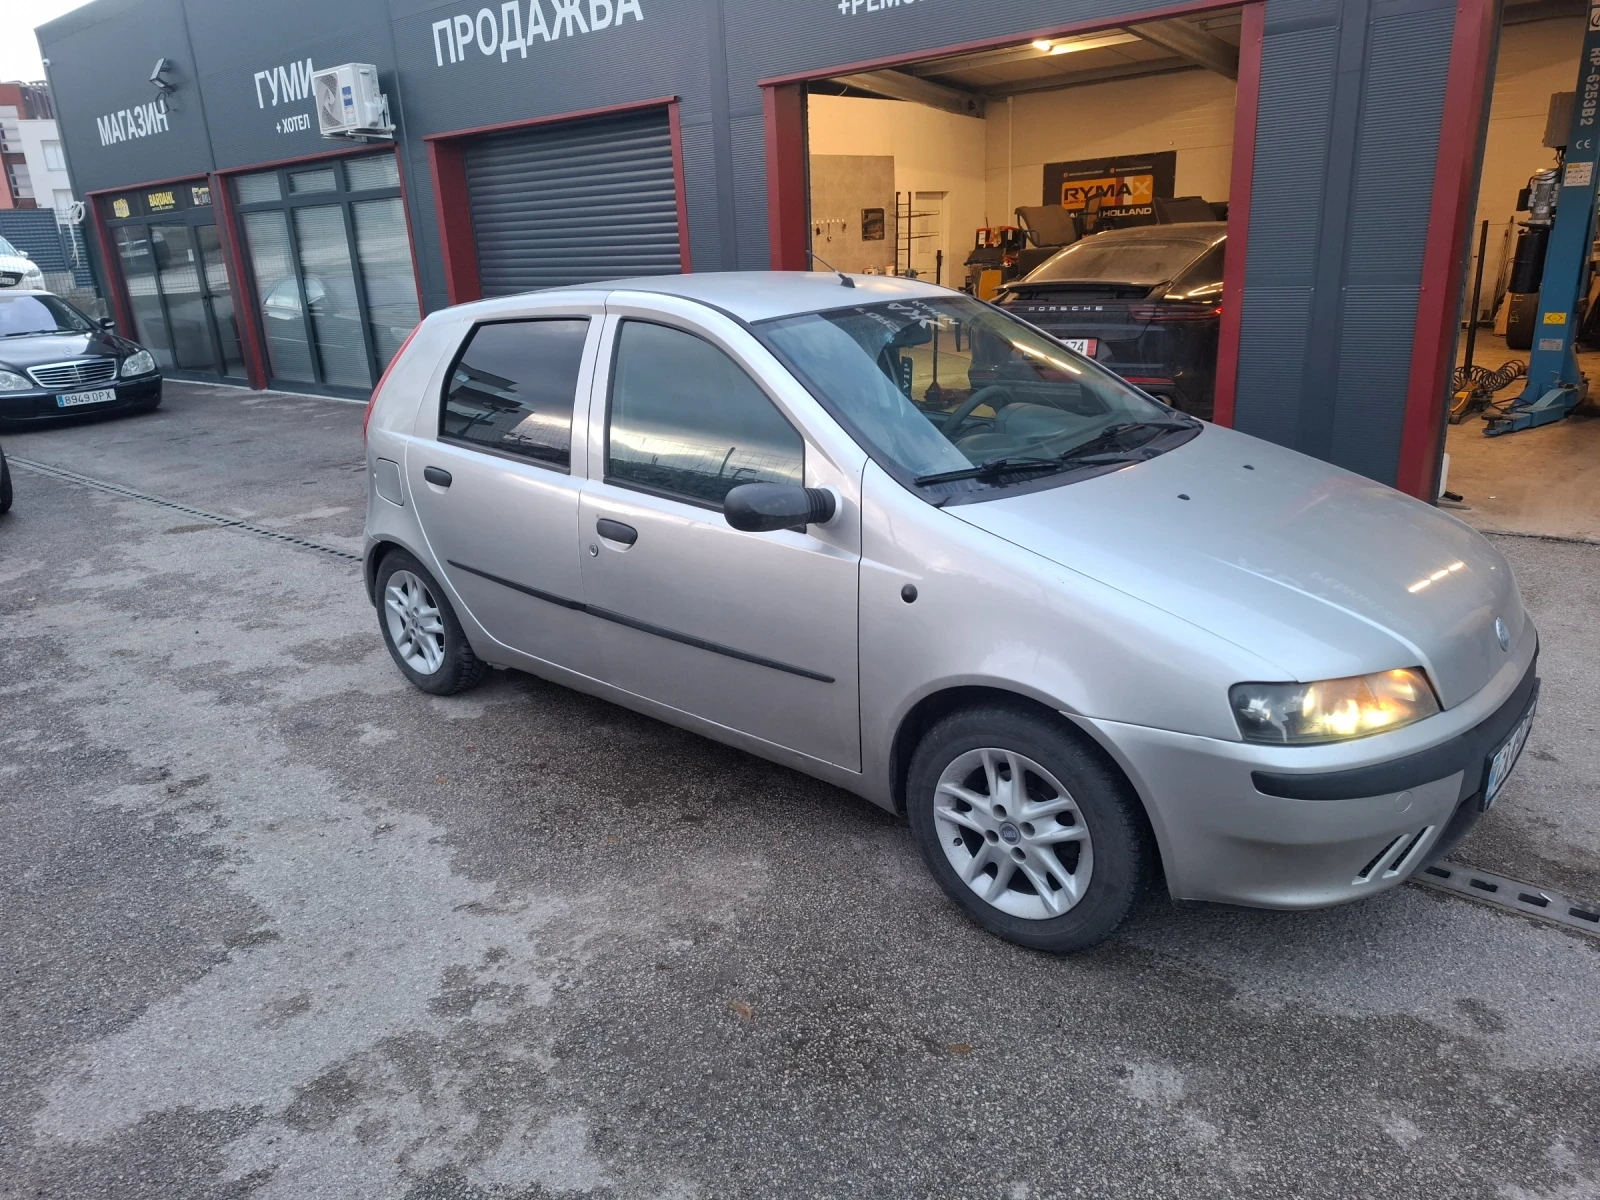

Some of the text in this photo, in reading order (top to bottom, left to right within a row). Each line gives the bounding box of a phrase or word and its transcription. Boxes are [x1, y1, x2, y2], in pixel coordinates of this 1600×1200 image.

[432, 0, 644, 67] ПРОДАЖБА
[254, 58, 316, 109] ГУМИ
[96, 99, 169, 146] МАГАЗИН
[1064, 181, 1151, 201] RYMAX
[1102, 207, 1152, 218] HOLLAND
[64, 394, 91, 405] 8949
